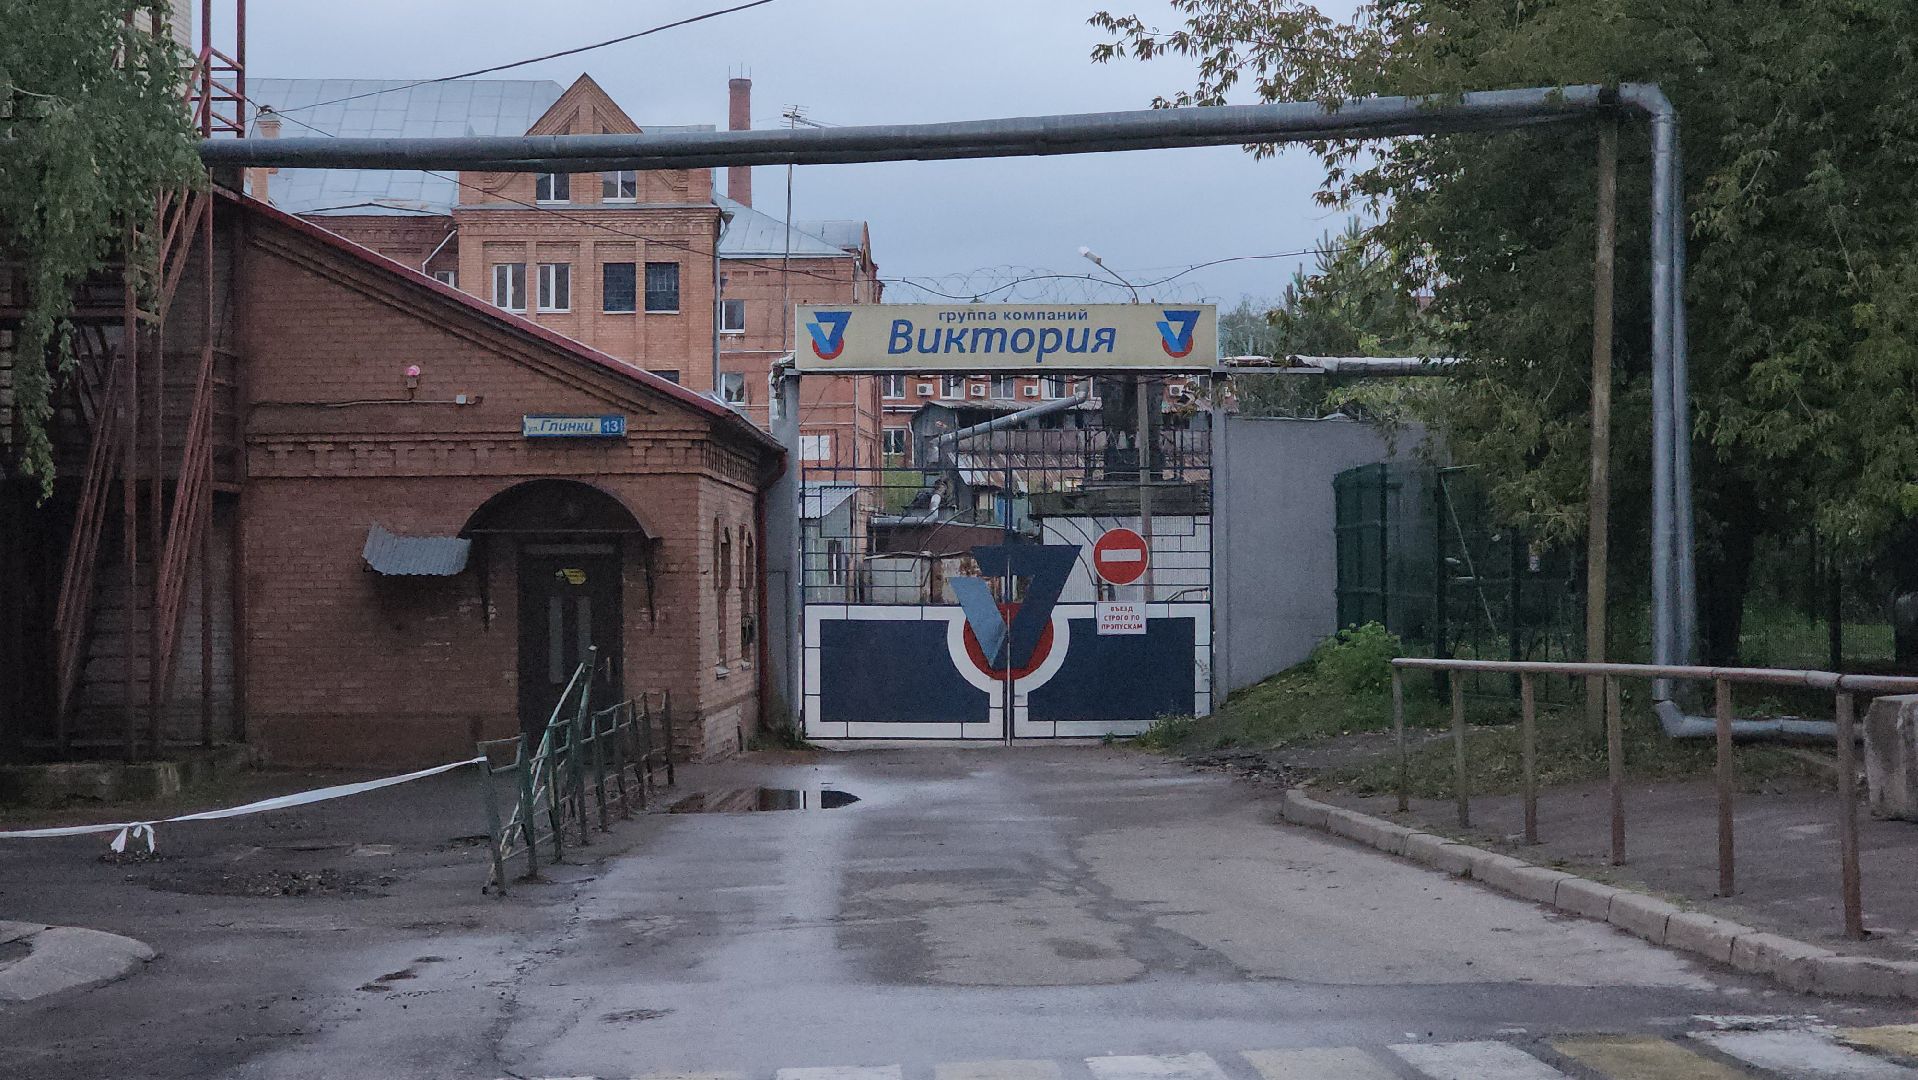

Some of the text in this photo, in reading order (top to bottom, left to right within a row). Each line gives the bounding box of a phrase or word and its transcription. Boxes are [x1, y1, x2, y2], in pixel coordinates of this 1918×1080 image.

[938, 309, 1088, 324] группа компаний
[887, 319, 1117, 363] Виктория
[540, 419, 594, 432] Глинки
[603, 420, 619, 432] 13
